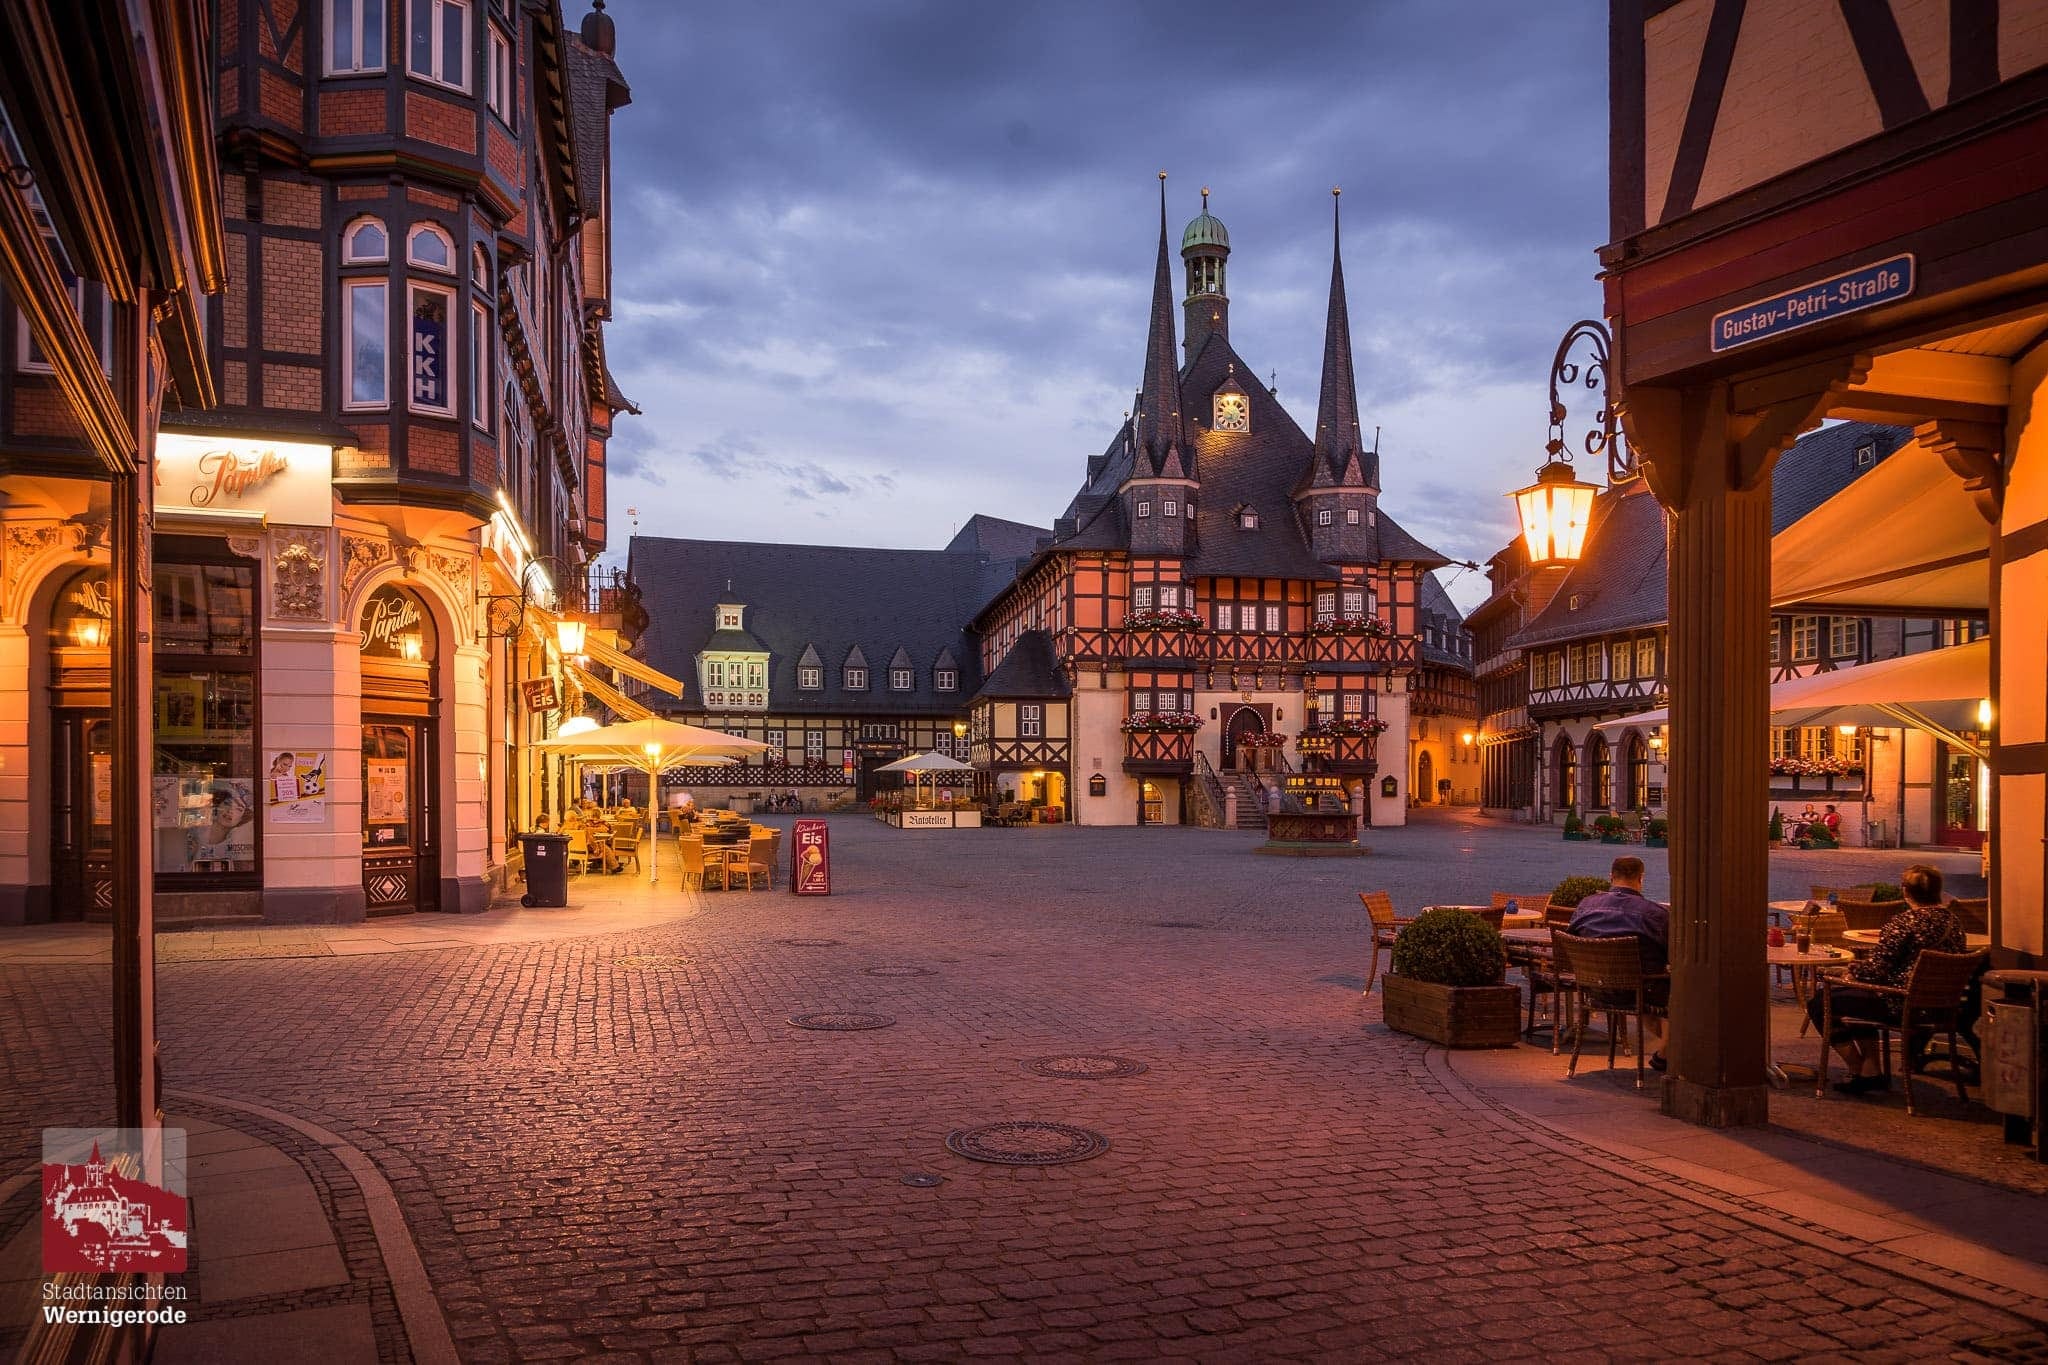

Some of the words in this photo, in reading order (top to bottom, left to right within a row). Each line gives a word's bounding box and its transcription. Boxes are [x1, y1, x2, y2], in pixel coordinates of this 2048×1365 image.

[1723, 270, 1900, 340] Gustav-Petri-Straße
[415, 331, 436, 400] KKH
[532, 693, 554, 708] Eis
[909, 815, 947, 825] Ratskeller
[802, 832, 822, 845] Eis
